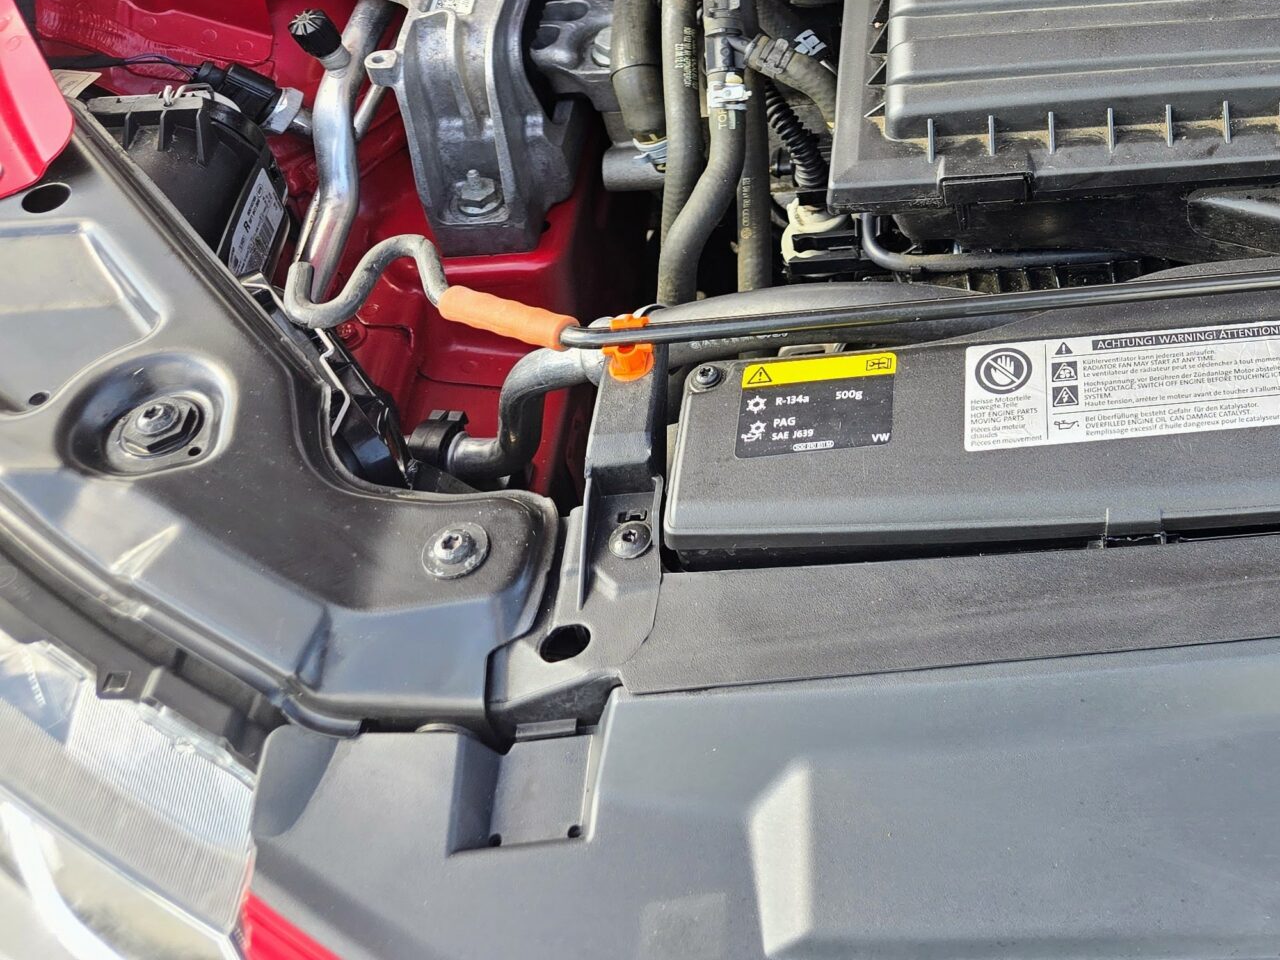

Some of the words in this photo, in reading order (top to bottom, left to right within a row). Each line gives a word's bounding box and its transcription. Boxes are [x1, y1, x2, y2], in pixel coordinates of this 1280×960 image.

[1097, 336, 1156, 349] ACHTUNG!
[1159, 332, 1216, 343] WARNING!
[1083, 355, 1136, 364] Kühlerventilator
[1092, 369, 1128, 377] ventilateur
[1172, 363, 1187, 372] peut
[1197, 359, 1232, 368] déclencher
[1084, 378, 1136, 387] Hochspannung,
[1193, 369, 1232, 378] Zündanlage
[1233, 373, 1270, 381] TOUCHING
[776, 395, 810, 406] R-134a
[836, 390, 863, 400] 500g
[995, 395, 1031, 403] Motorteile
[1097, 412, 1139, 421] Überfüllung
[1220, 402, 1259, 410] Katalysator.
[773, 417, 796, 427] PAG
[1086, 421, 1126, 429] OVERFILLED
[1086, 428, 1129, 436] Remplissage
[1183, 420, 1220, 429] dangereux
[772, 431, 789, 440] SAE
[792, 429, 814, 439] J639
[872, 433, 890, 442] VW
